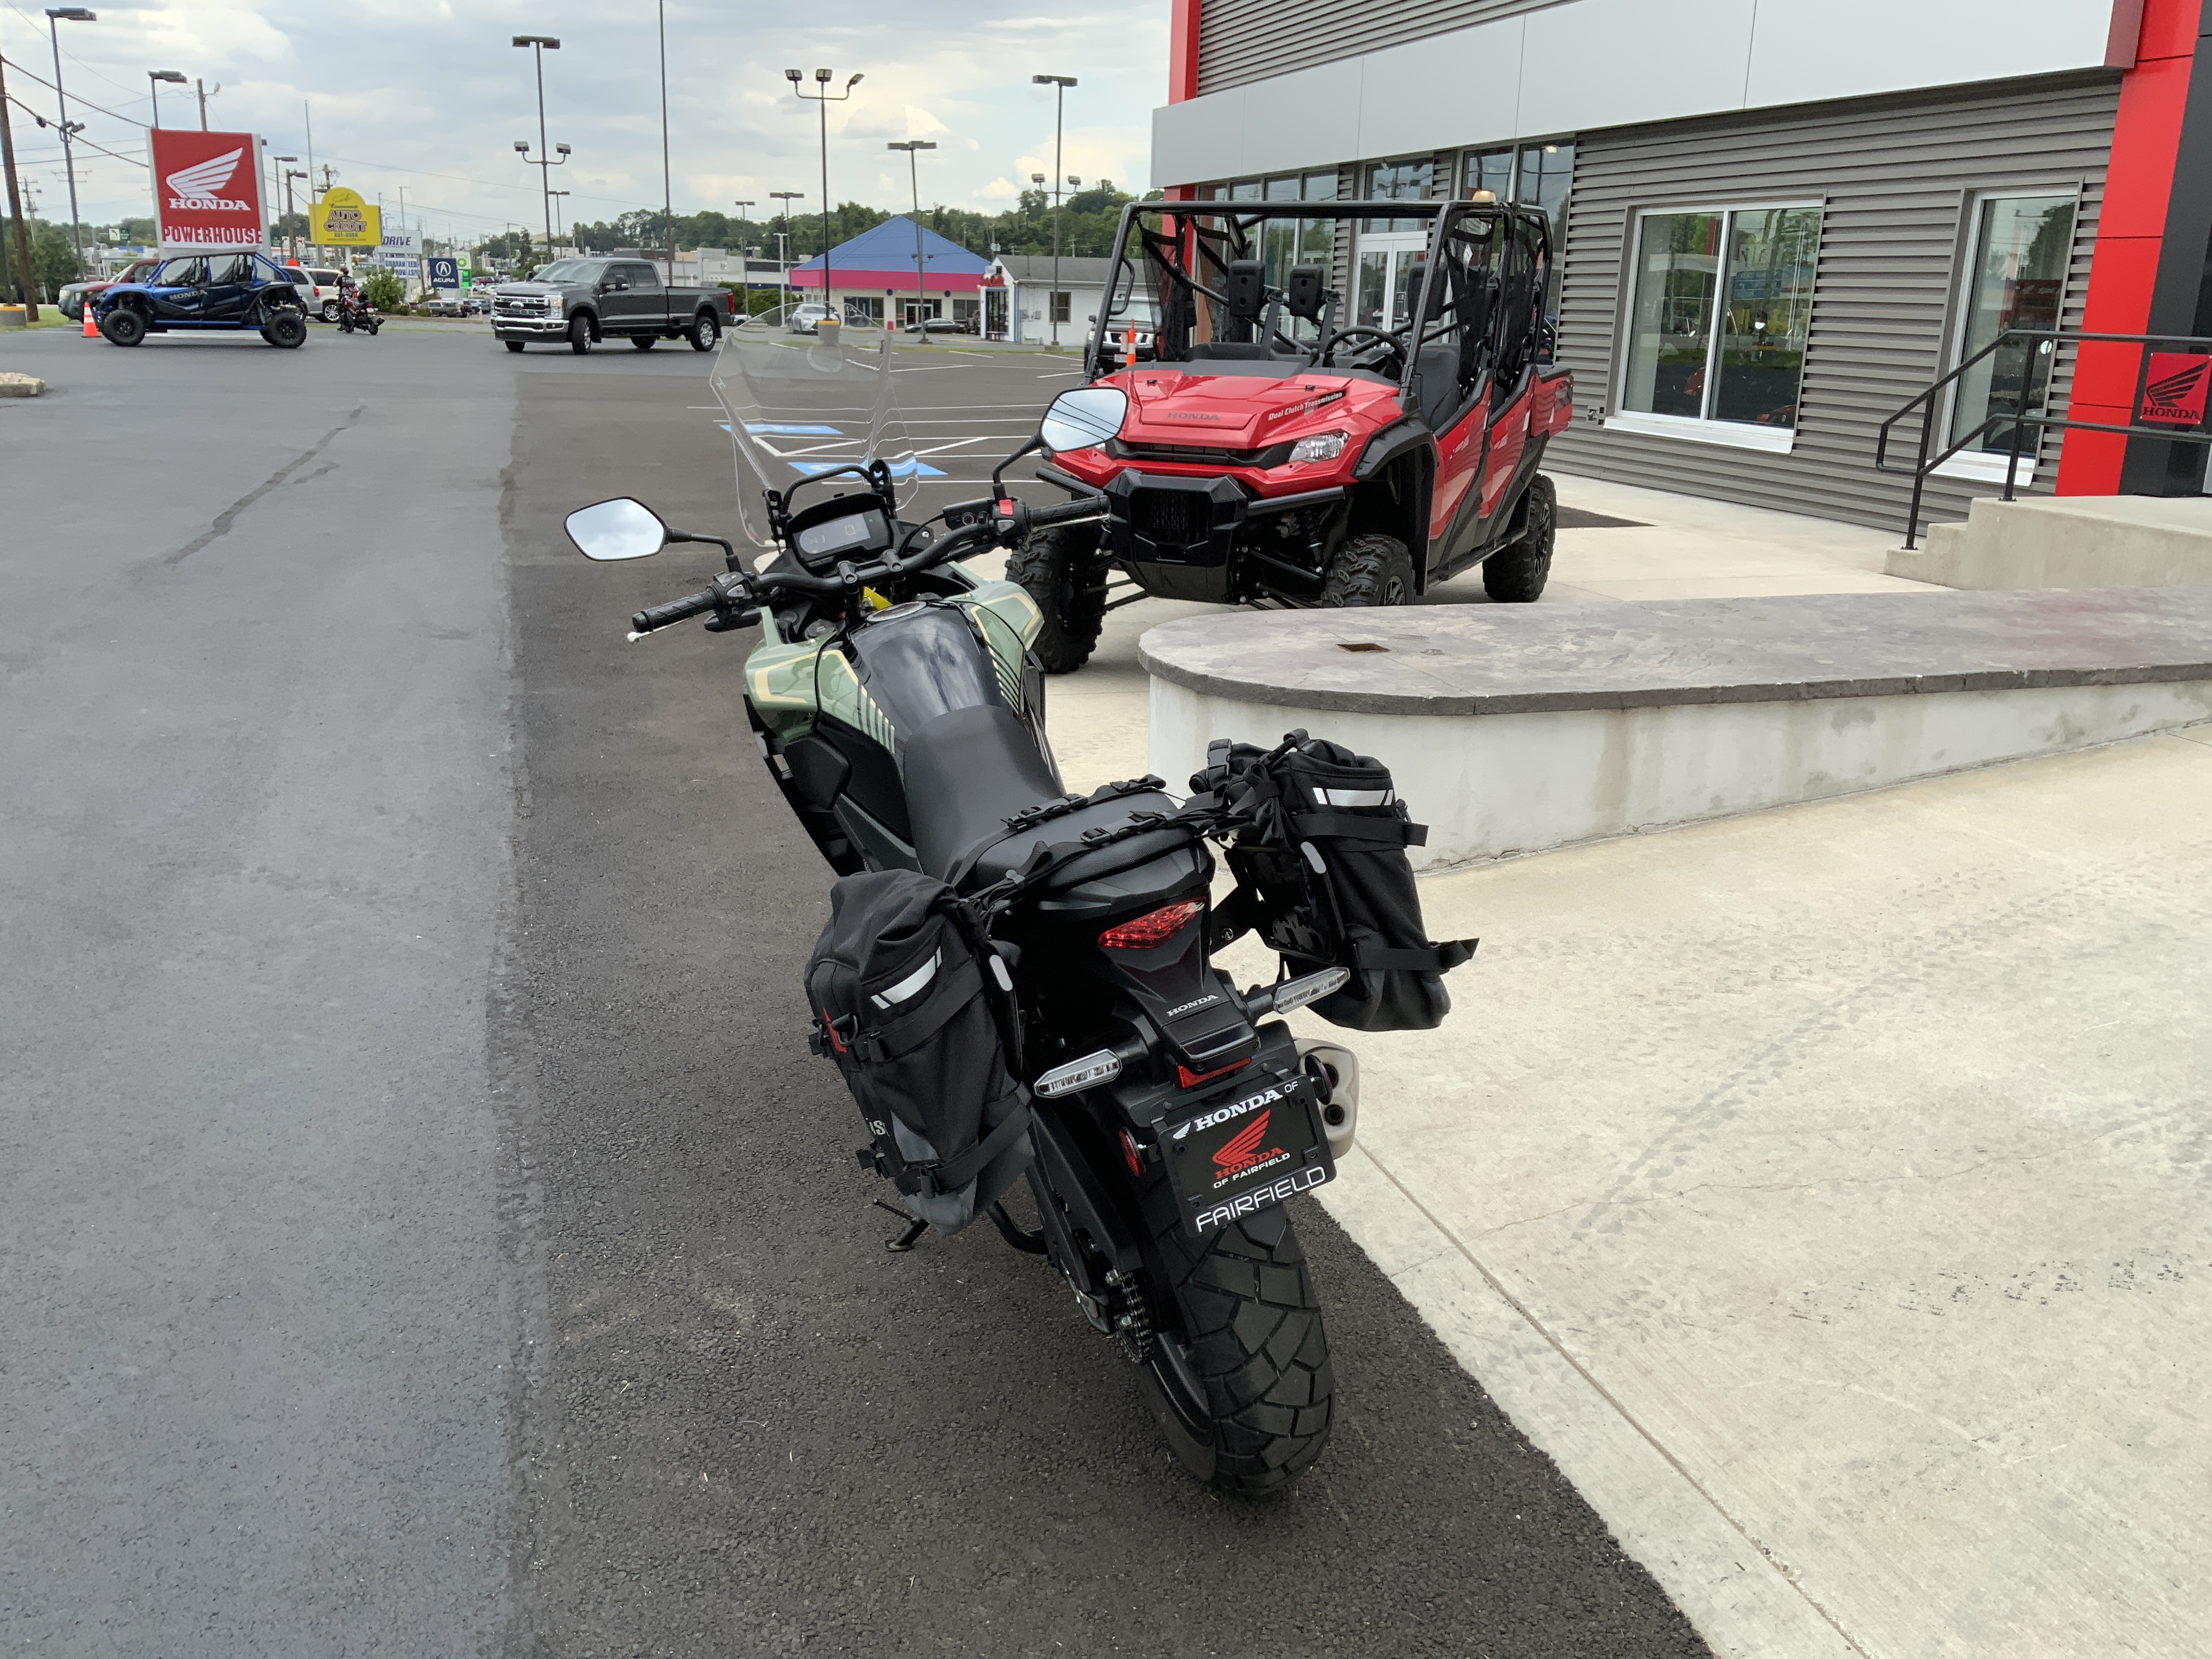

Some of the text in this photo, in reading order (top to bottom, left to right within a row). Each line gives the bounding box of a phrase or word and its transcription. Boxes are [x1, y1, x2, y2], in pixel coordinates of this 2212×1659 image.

[168, 198, 251, 210] HONDA
[328, 210, 361, 221] AUTO
[162, 226, 262, 244] POWERHOUSE
[324, 221, 366, 232] CREDIT
[169, 289, 208, 301] HONDA
[1268, 392, 1342, 421] Dual Clutch Transmission
[2143, 407, 2201, 419] HONDA
[1166, 995, 1219, 1017] HONDA
[1194, 1081, 1299, 1131] HONDA OF
[1213, 1153, 1290, 1189] OF FAIRFIELD
[1215, 1147, 1284, 1180] HONDA
[1196, 1166, 1326, 1233] FAIRFIELD
